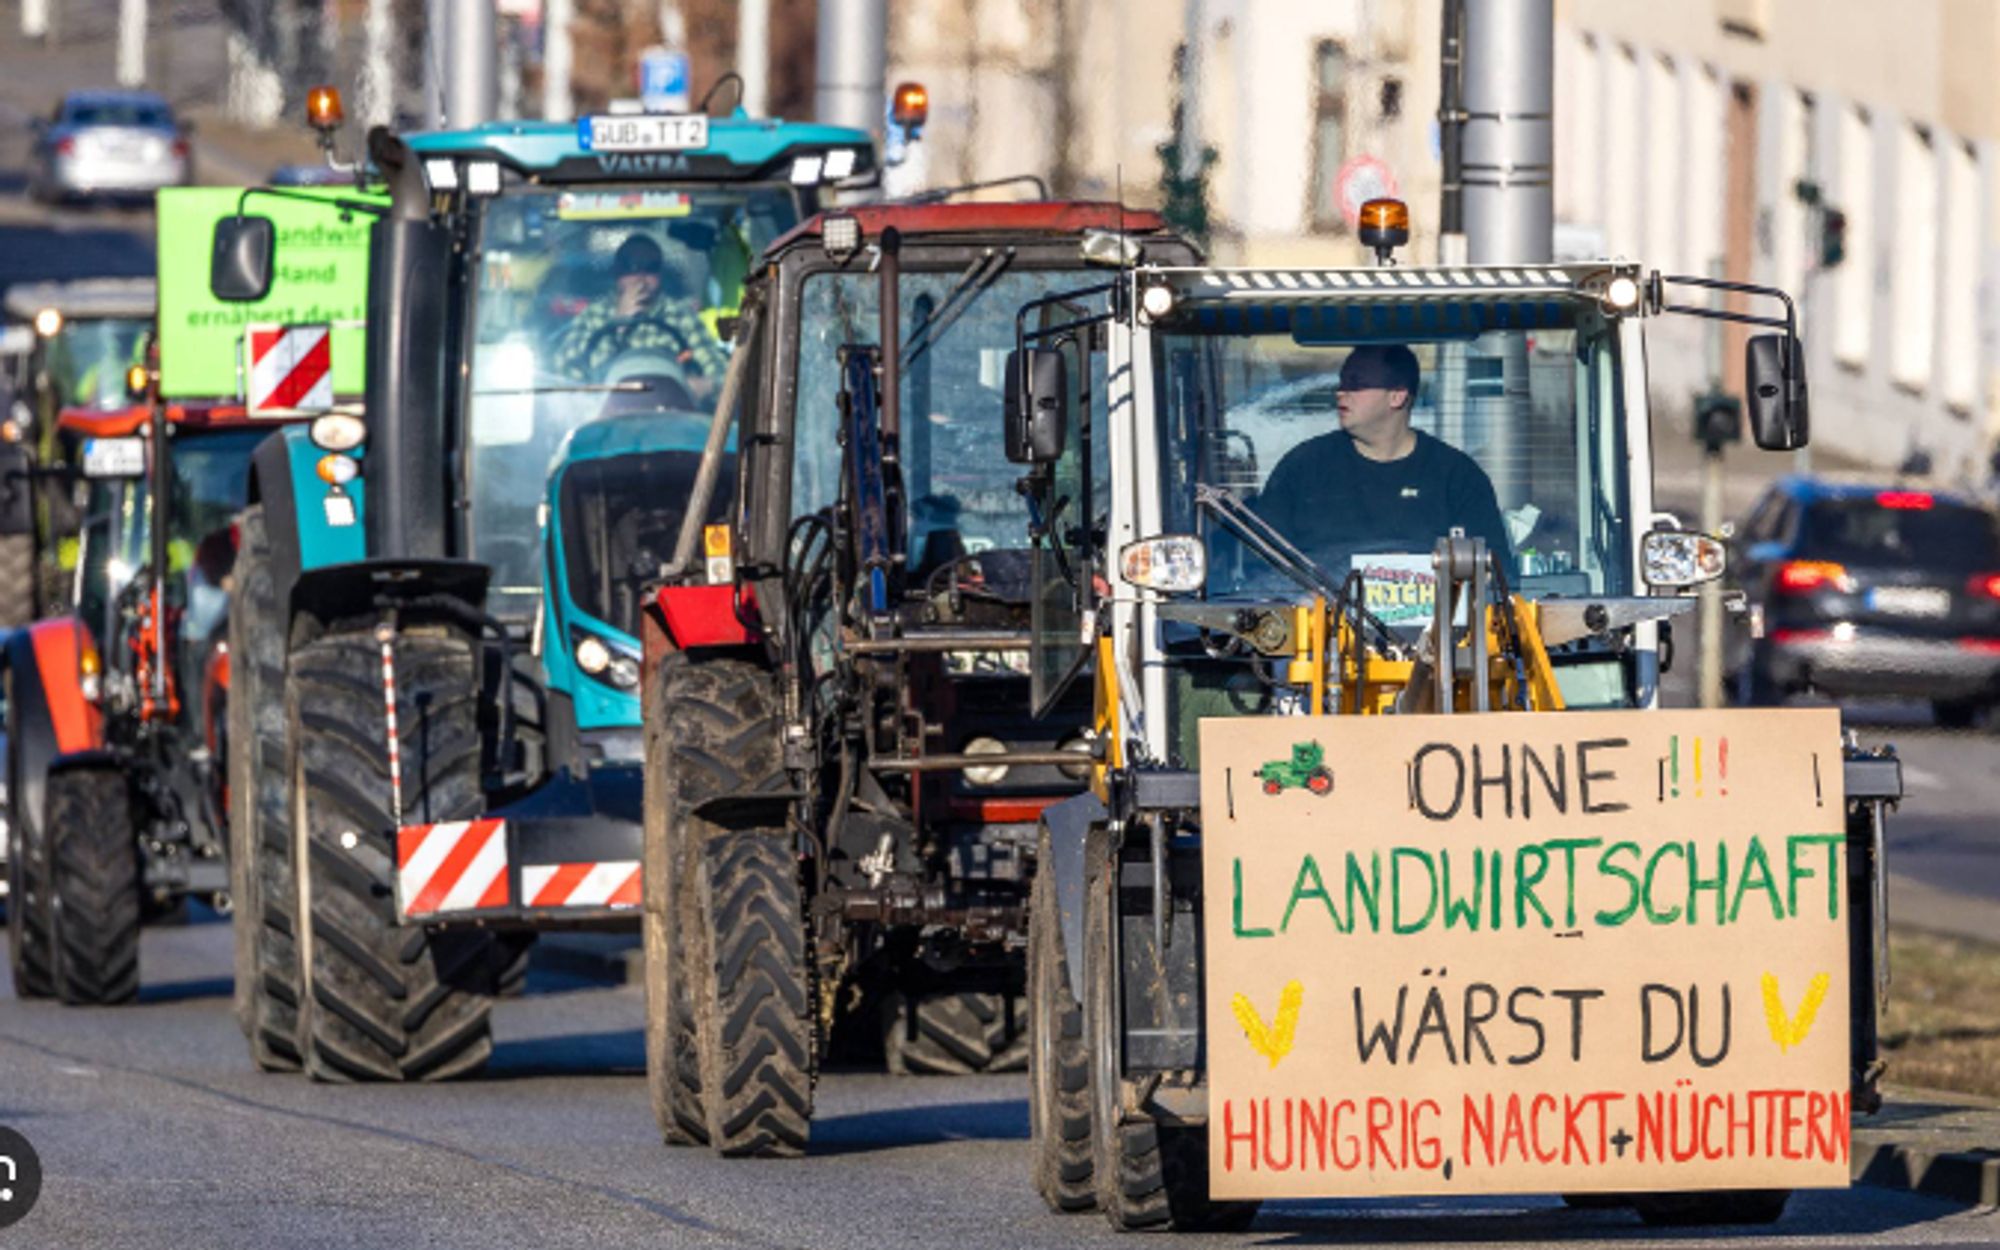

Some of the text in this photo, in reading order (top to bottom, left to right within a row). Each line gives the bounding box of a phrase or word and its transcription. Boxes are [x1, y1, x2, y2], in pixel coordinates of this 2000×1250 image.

[597, 153, 689, 175] VALTRA
[1364, 583, 1437, 606] NICH
[1412, 737, 1631, 822] OHNE
[1232, 833, 1847, 940] LANDWIRTSCHAFT
[1352, 966, 1732, 1068] WÄRST DU
